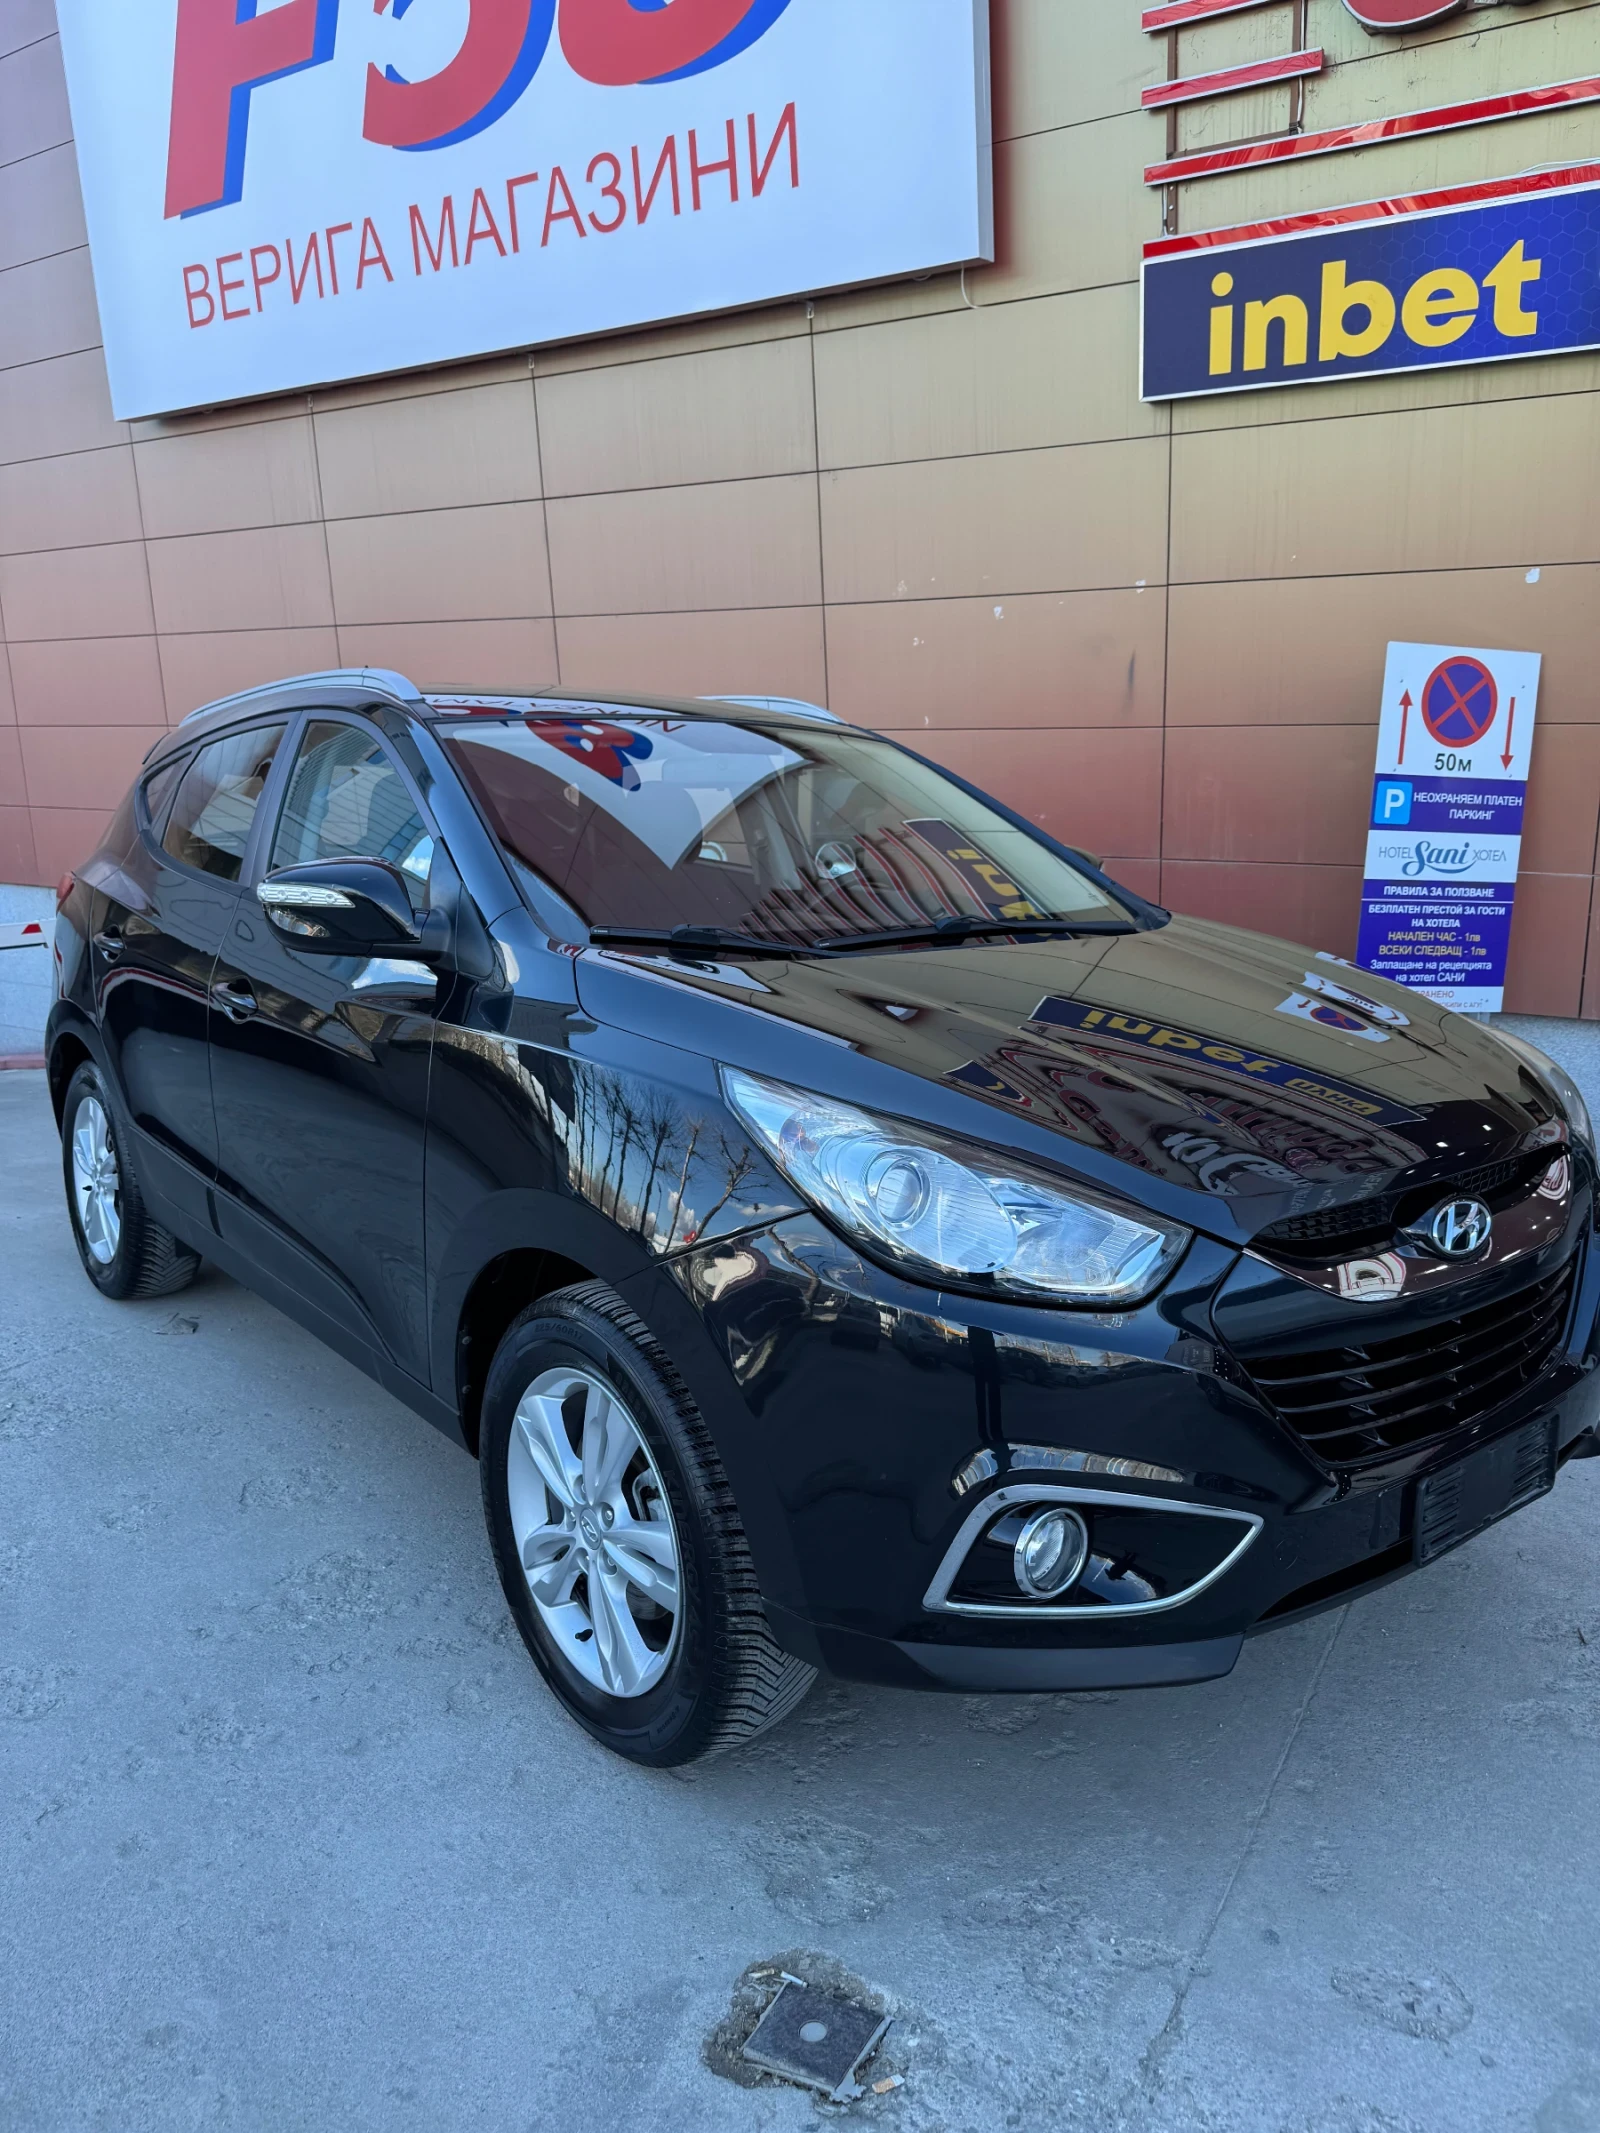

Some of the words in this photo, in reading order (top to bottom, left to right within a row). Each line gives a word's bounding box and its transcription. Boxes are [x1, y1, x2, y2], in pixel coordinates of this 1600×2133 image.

[183, 217, 394, 330] ВЕРИГА
[408, 102, 801, 277] МАГАЗИНИ
[1208, 239, 1541, 376] inbet
[1384, 788, 1405, 819] P
[1414, 792, 1482, 805] НЕОХРАНЯЕМ
[1484, 795, 1523, 807] ПЛАТЕН
[1449, 809, 1495, 820] ПАРКИНГ
[1378, 846, 1414, 859] HOTEL
[1402, 840, 1475, 877] Sani
[1472, 849, 1507, 862] ХОТЕЛ
[1383, 885, 1428, 896] ПРАВИЛА
[1430, 886, 1442, 896] ЗА
[1444, 887, 1495, 898] ПОЛЗВАНЕ
[1368, 904, 1420, 914] БЕЗПЛАТЕН
[1421, 904, 1462, 915] ПРЕСТОЙ
[1463, 905, 1475, 915] ЗА
[1477, 906, 1505, 916] ГОСТИ
[1411, 918, 1424, 927] НА
[1425, 918, 1460, 928] ХОТЕЛА
[1387, 931, 1435, 941] НАЧАЛЕН
[1436, 931, 1457, 941] ЧАС
[1378, 945, 1412, 955] ВСЕКИ
[1413, 945, 1462, 957] СЛЕДВАЩ
[1370, 959, 1424, 970] Заплащане
[1425, 962, 1436, 970] на
[1438, 961, 1492, 972] рецепцията
[1395, 974, 1407, 982] на
[1408, 974, 1435, 982] хотел
[1437, 972, 1466, 982] САНИ
